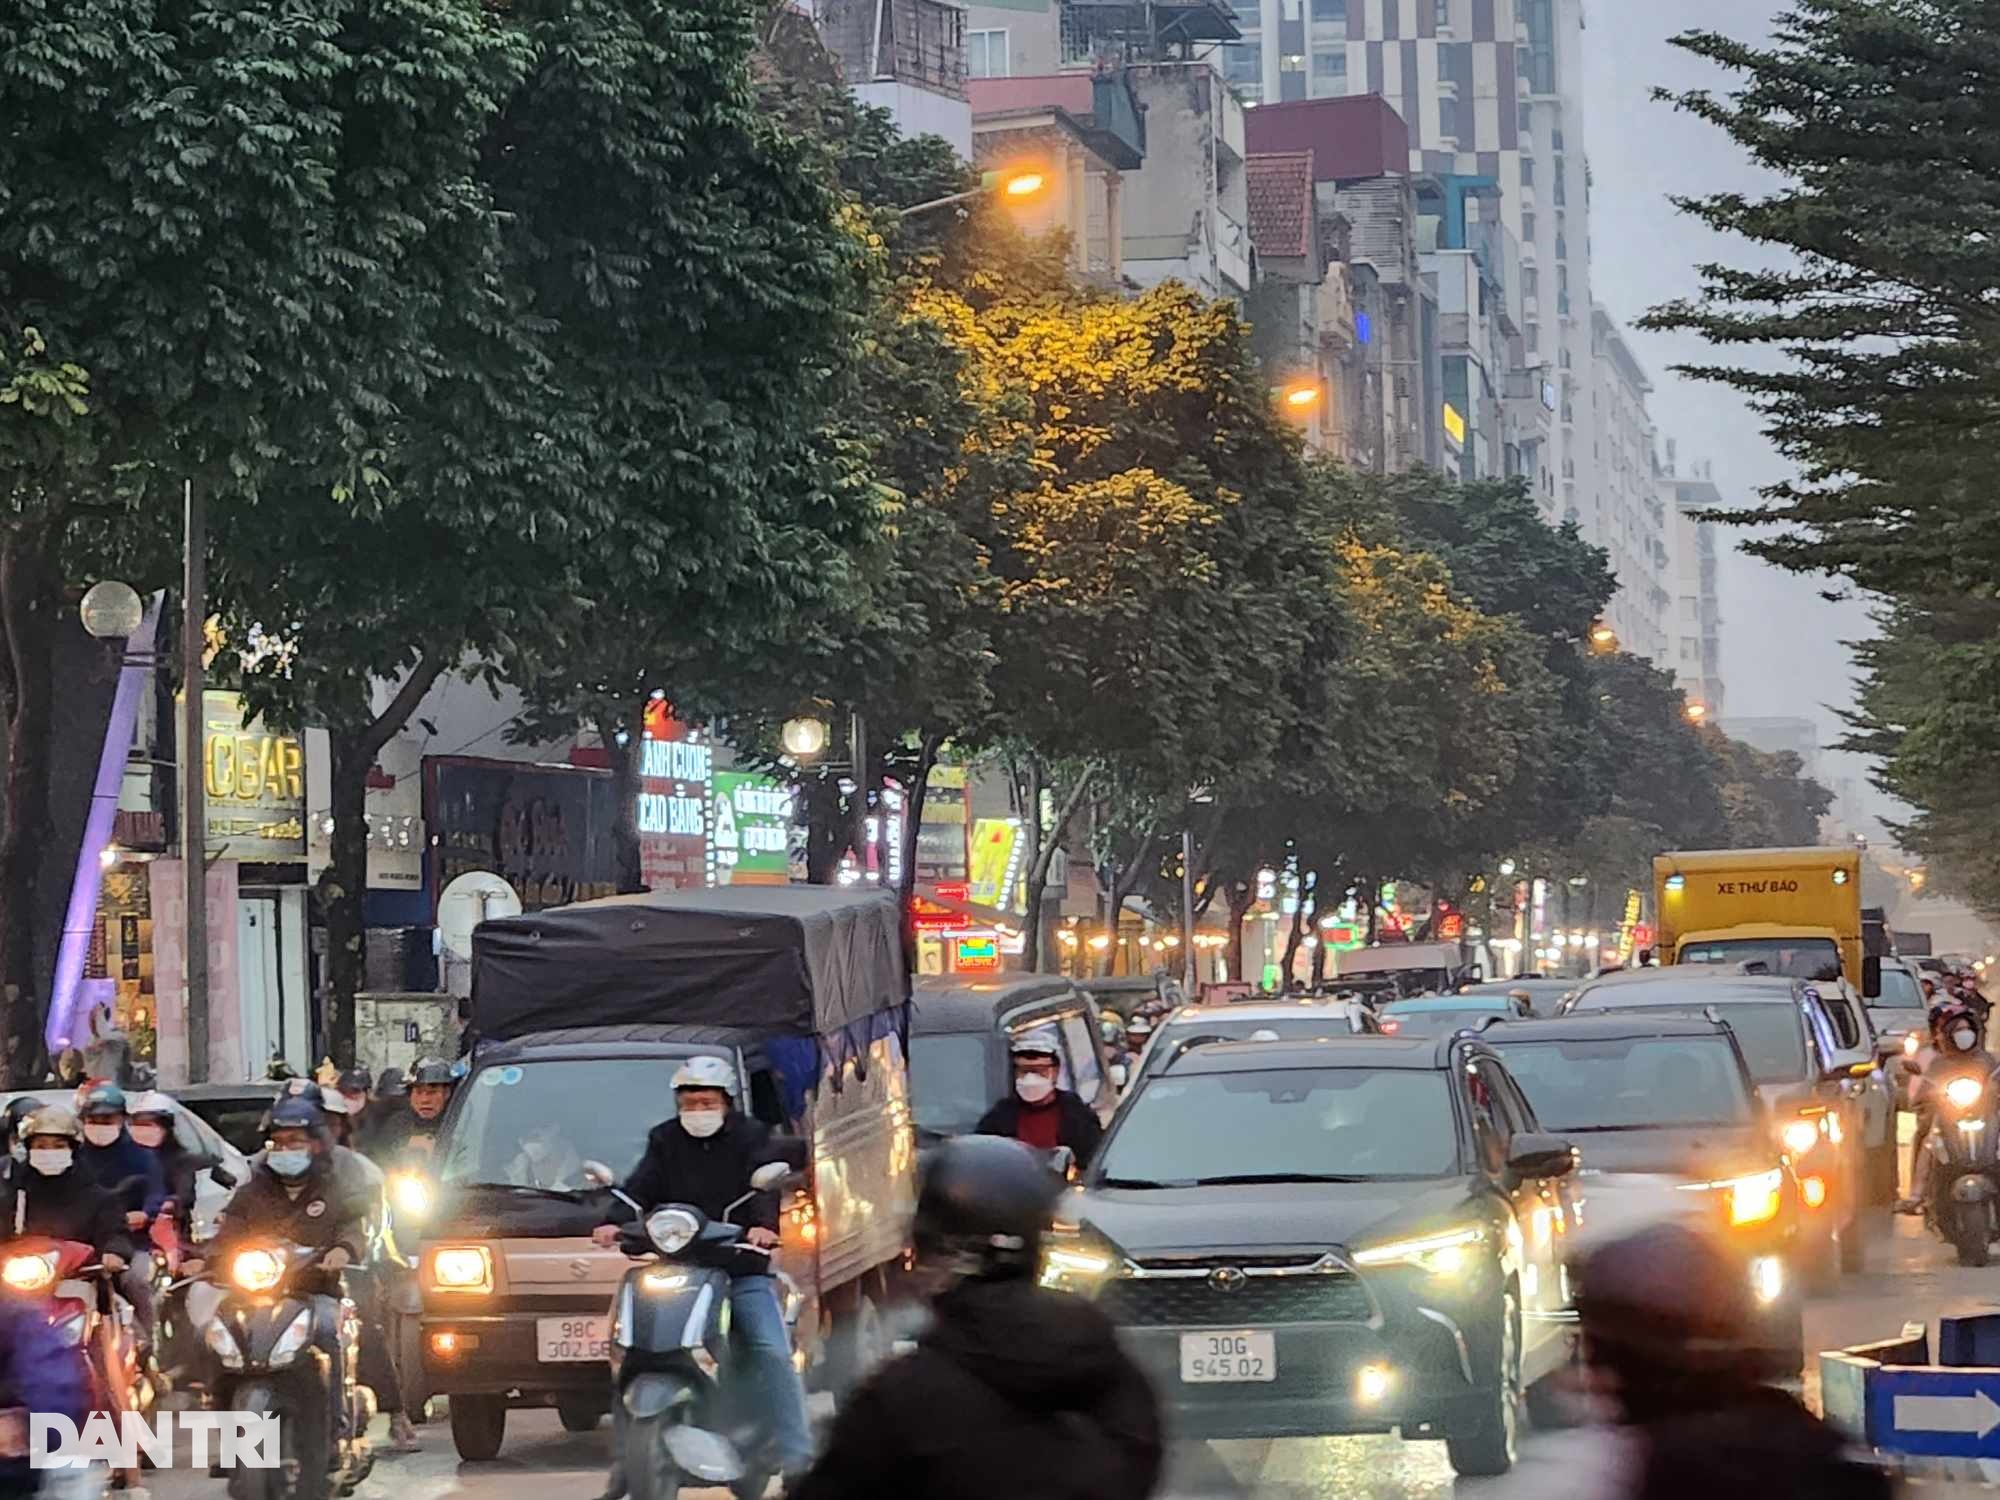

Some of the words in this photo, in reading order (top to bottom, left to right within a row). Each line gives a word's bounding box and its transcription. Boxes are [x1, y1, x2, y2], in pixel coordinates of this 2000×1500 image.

[638, 794, 667, 833] CAO
[1717, 882, 1735, 895] XE
[1738, 880, 1768, 893] THƯ
[561, 1321, 596, 1338] 98C
[1208, 1336, 1247, 1356] 30G
